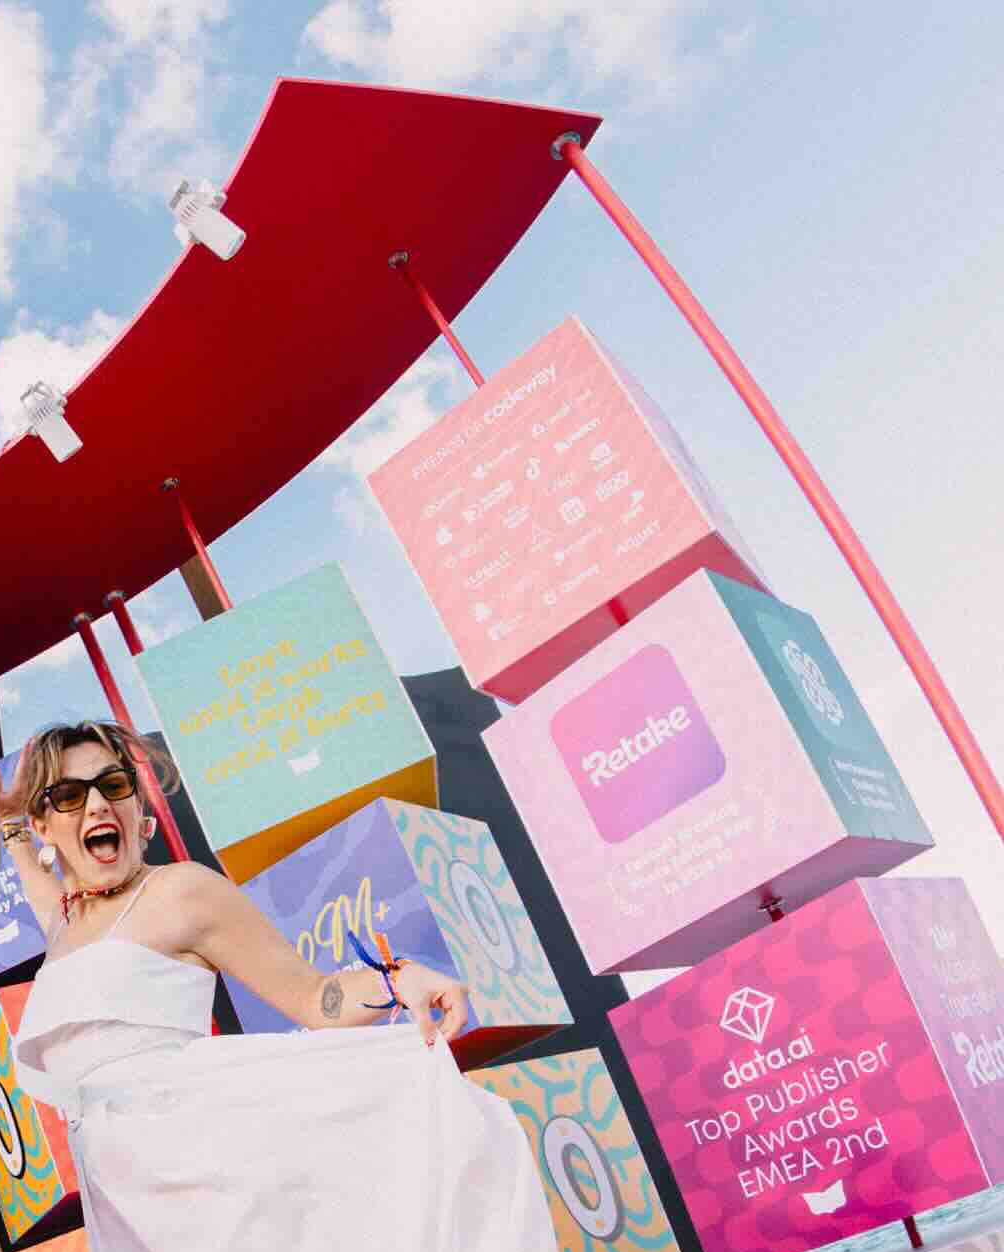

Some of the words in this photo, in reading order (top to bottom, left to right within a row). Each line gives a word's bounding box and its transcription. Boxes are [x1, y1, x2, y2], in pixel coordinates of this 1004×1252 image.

[581, 704, 693, 788] Retake
[685, 1110, 742, 1146] Top
[745, 1041, 888, 1121] Publisher
[723, 1027, 815, 1089] data.ai
[737, 1146, 825, 1200] EMEA
[825, 1117, 890, 1166] 2nd
[744, 1097, 860, 1162] Awards
